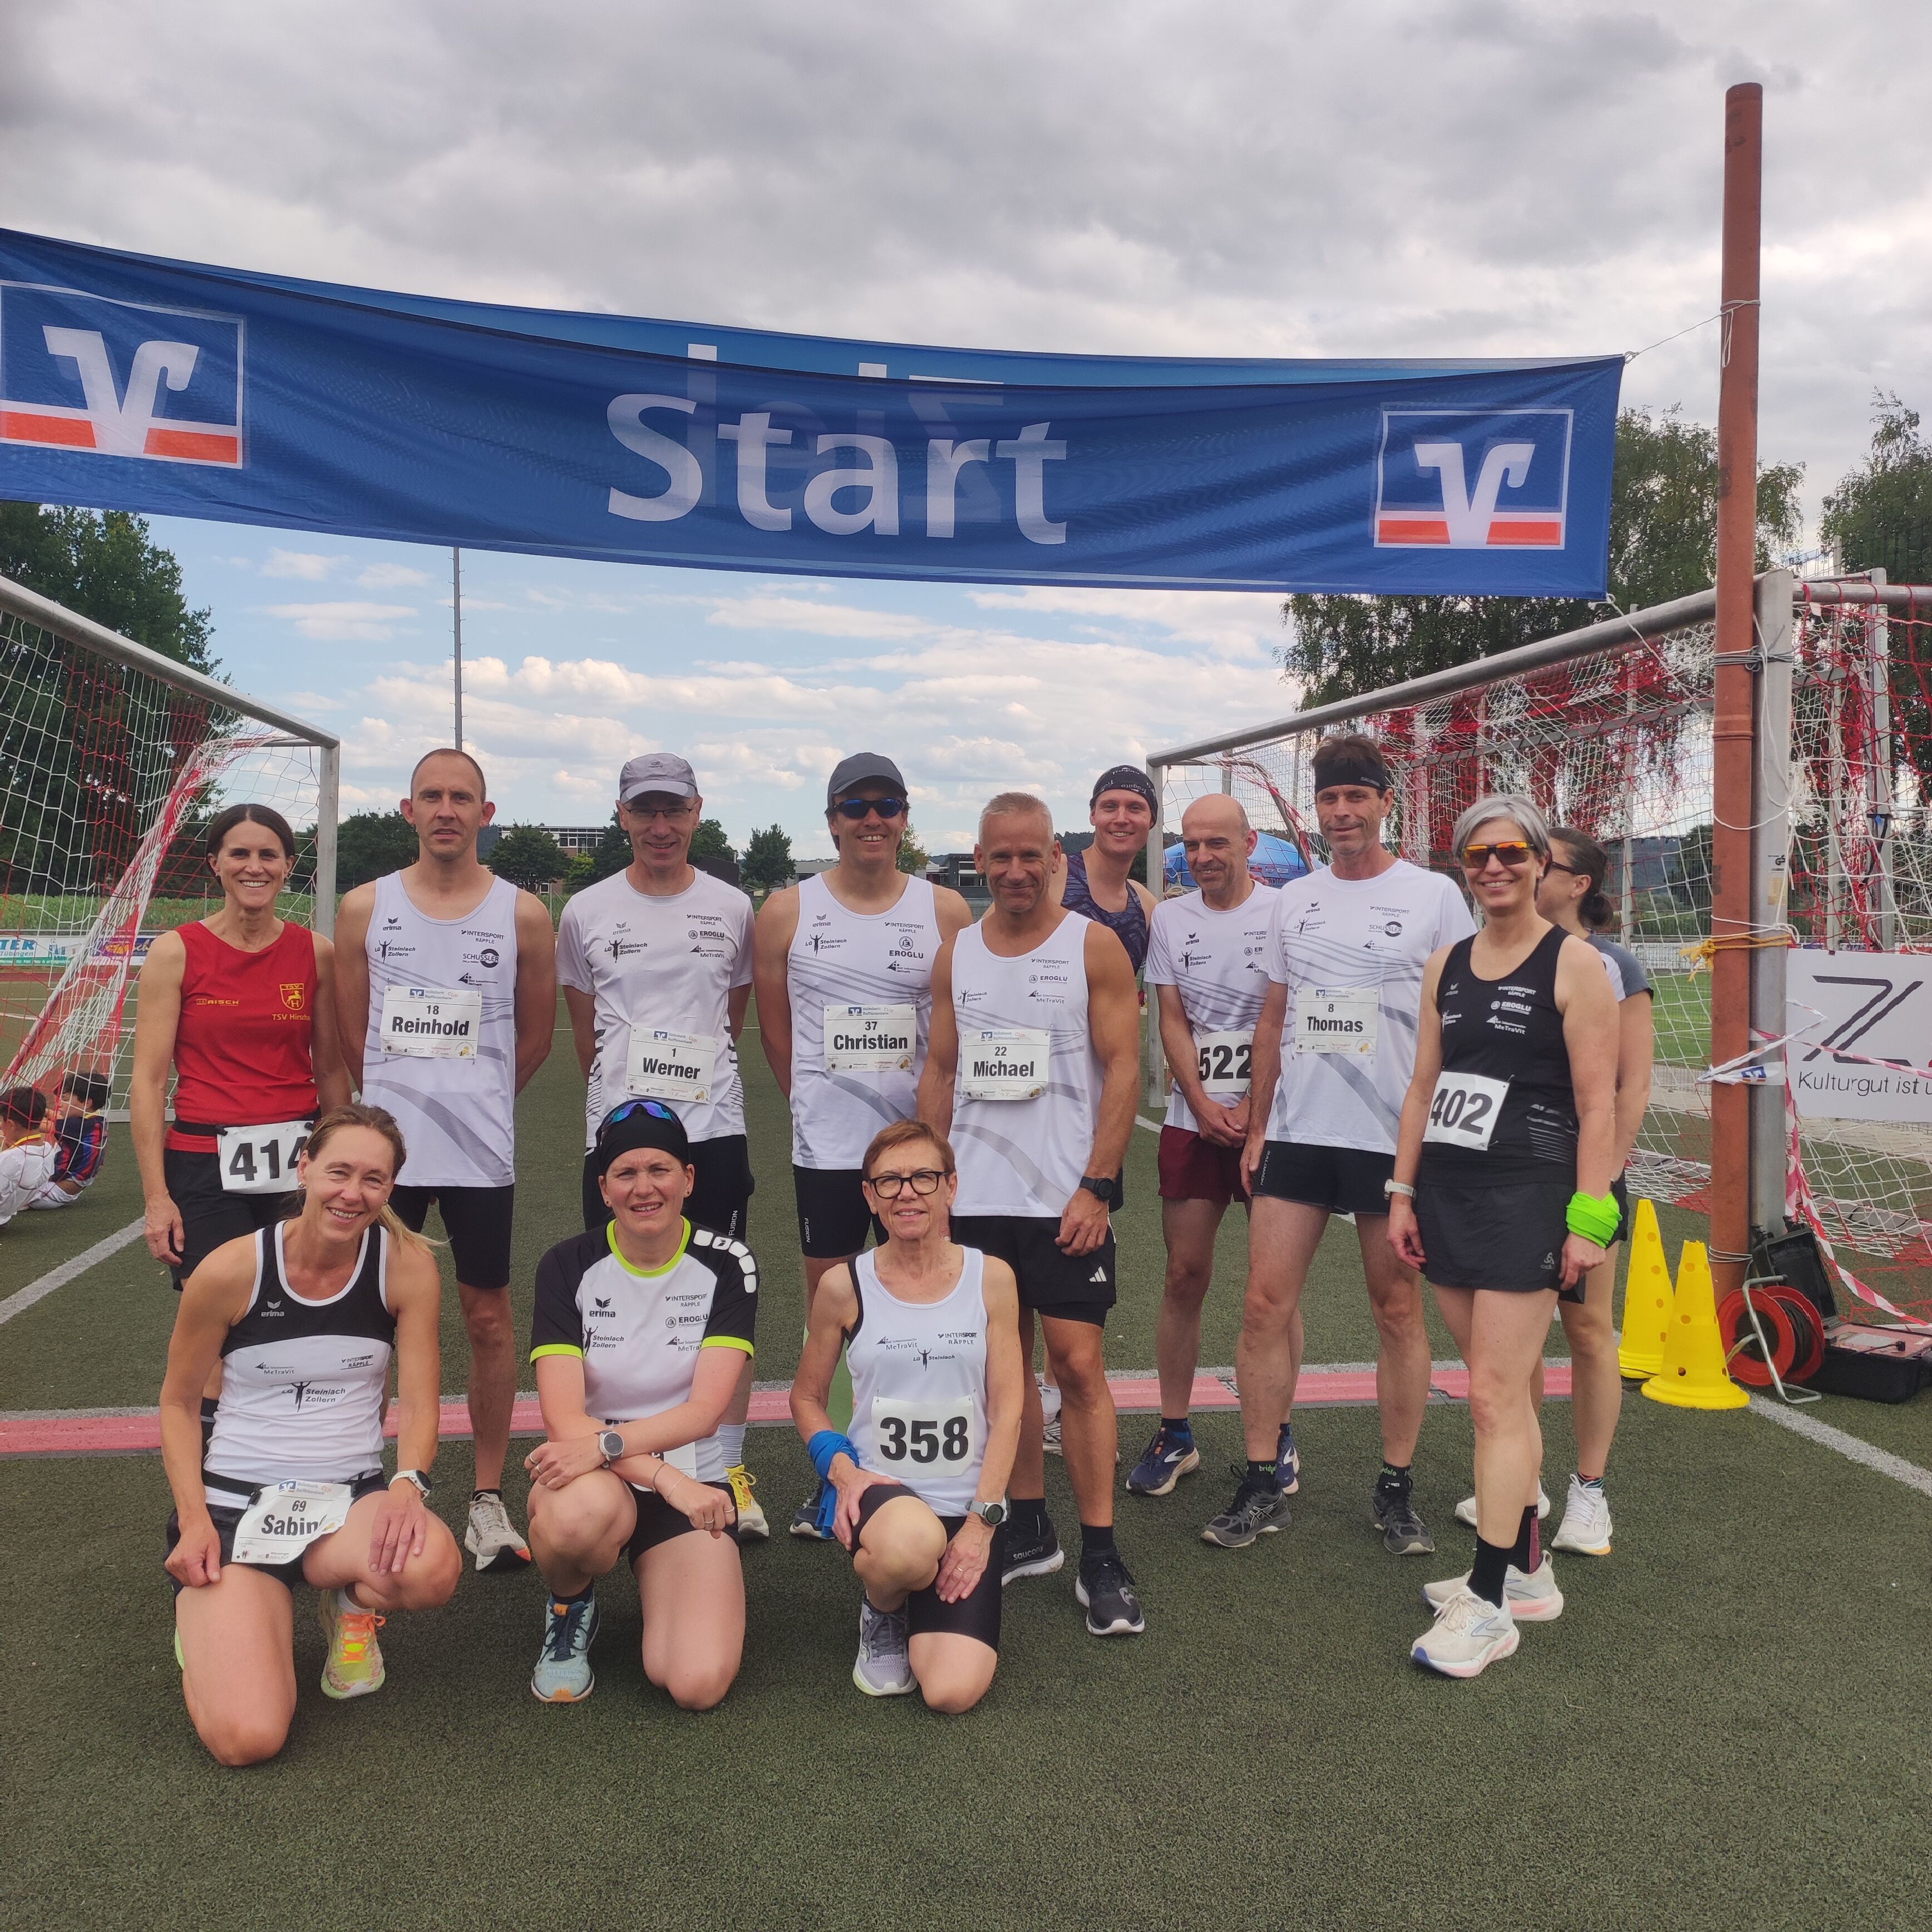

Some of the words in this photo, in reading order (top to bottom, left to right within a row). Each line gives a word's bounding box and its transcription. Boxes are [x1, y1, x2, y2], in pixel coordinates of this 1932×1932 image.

[606, 393, 1067, 545] Start
[1375, 906, 1410, 915] INTERSPORT
[467, 930, 505, 940] INTERSPORT
[889, 950, 924, 959] EROGLU
[426, 1004, 440, 1014] 18
[1328, 1003, 1334, 1012] 8
[1501, 1001, 1532, 1012] EROGLU
[392, 1016, 470, 1036] Reinhold
[865, 1021, 878, 1031] 37
[1307, 1016, 1363, 1033] Thomas
[1494, 1024, 1526, 1034] MeTraVit
[834, 1034, 908, 1050] Christian
[672, 1048, 677, 1057] 1
[994, 1047, 1007, 1056] 22
[1199, 1044, 1253, 1081] 522
[643, 1057, 701, 1080] Werner
[973, 1061, 1034, 1077] Michael
[1798, 1071, 1889, 1097] Kulturgut
[1896, 1076, 1919, 1095] ist
[1431, 1088, 1493, 1135] 402
[229, 1136, 308, 1181] 414
[728, 1210, 738, 1236] FUSION
[589, 1309, 616, 1318] erima
[678, 1313, 708, 1323] EROGLU
[885, 1342, 918, 1351] MeTraVit
[347, 1354, 373, 1363] INTERSPORT
[880, 1416, 969, 1463] 358
[292, 1500, 307, 1512] 69
[1013, 1544, 1044, 1561] saucony
